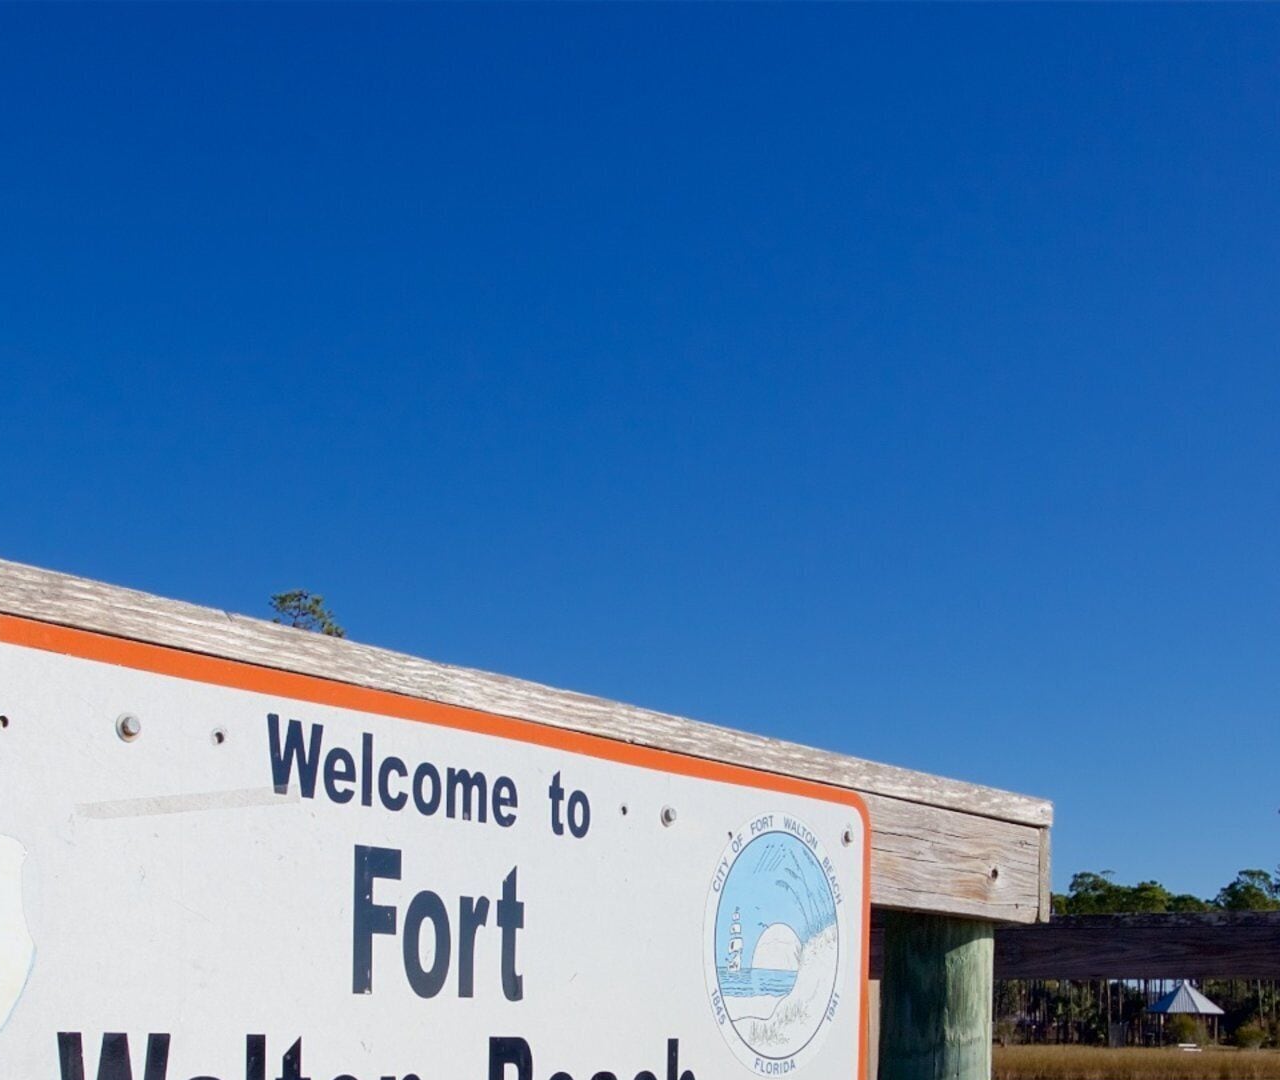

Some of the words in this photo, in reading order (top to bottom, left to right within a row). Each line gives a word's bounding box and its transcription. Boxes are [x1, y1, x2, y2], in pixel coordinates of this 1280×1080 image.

[268, 714, 517, 827] Welcome
[550, 772, 589, 837] to
[713, 859, 729, 893] CITY
[731, 833, 744, 855] OF
[749, 814, 774, 836] FORT
[783, 816, 819, 850] WALTON
[822, 856, 842, 906] BEACH
[353, 845, 523, 1001] Fort
[753, 1058, 797, 1077] FLORIDA
